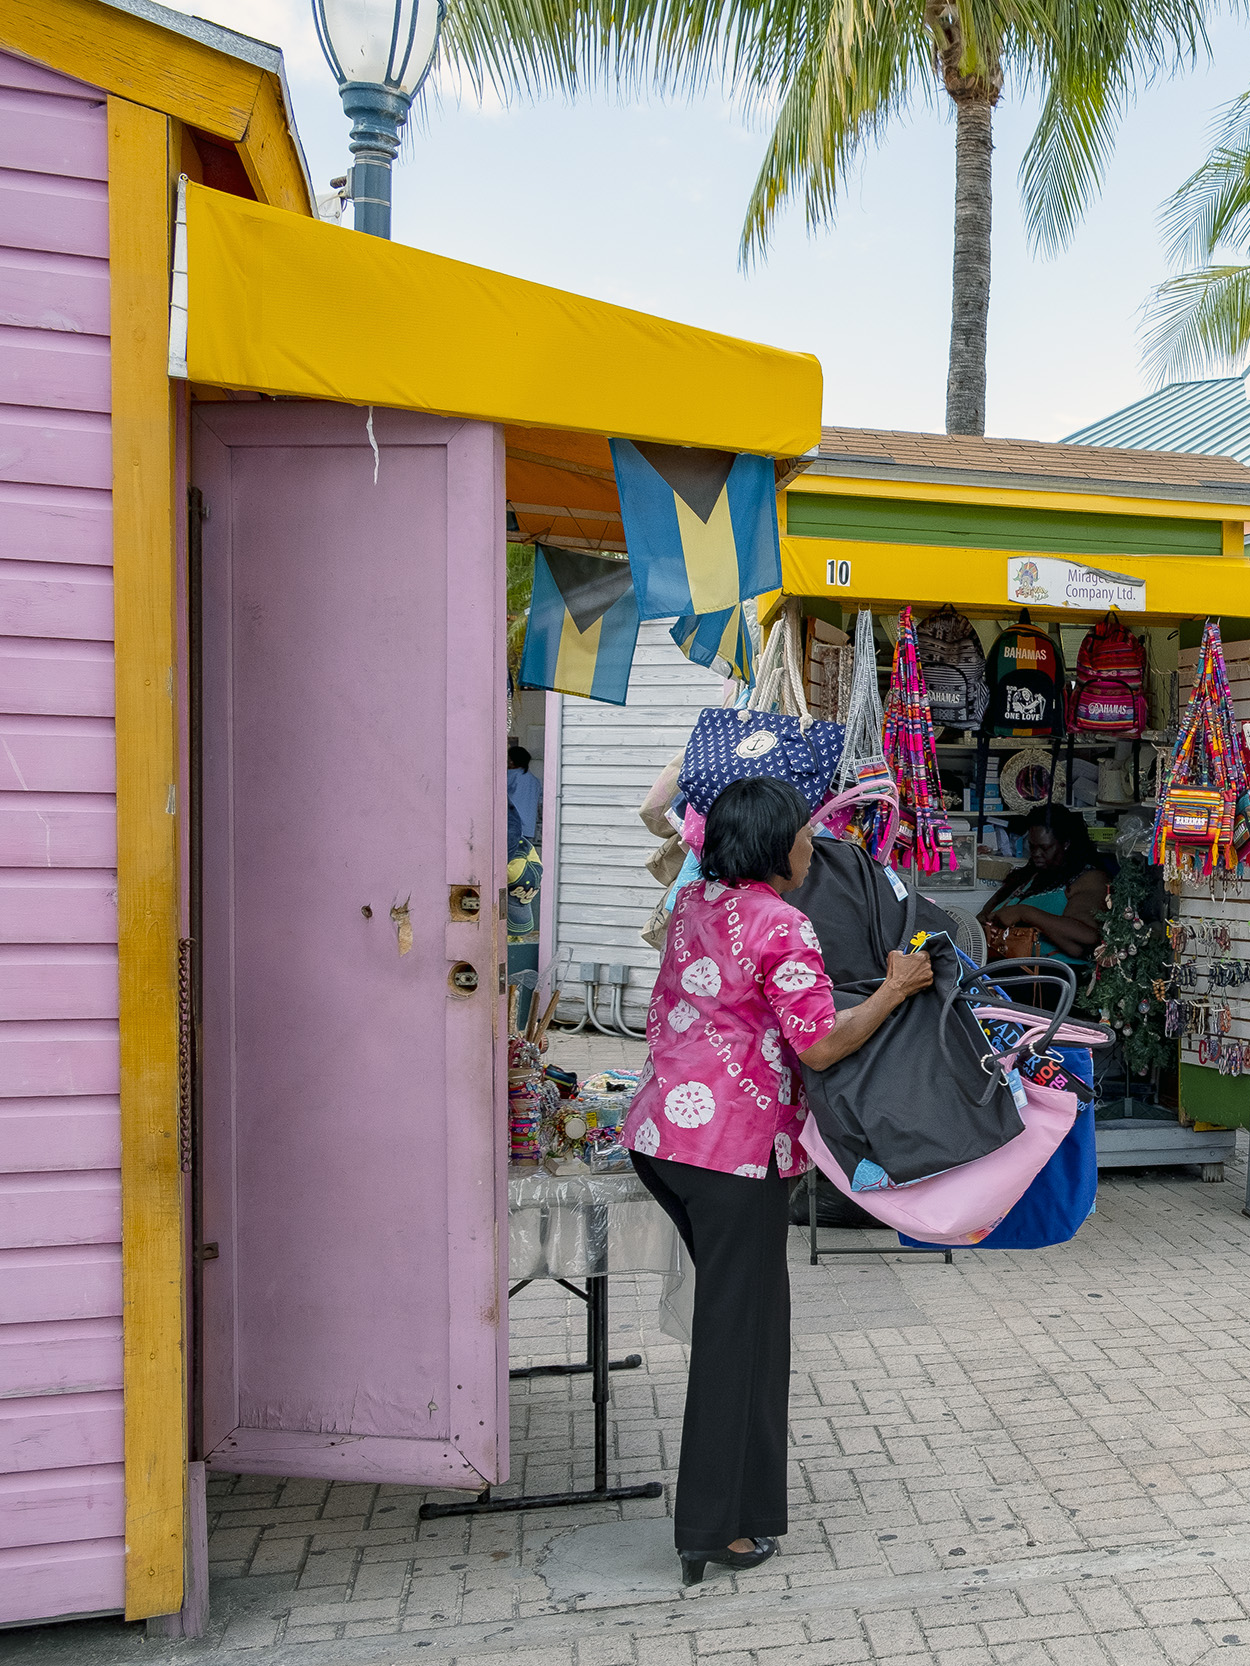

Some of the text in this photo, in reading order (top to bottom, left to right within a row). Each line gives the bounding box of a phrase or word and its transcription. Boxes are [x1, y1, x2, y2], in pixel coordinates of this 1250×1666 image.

[828, 560, 849, 585] 10
[1066, 584, 1136, 602] Company Ltd.
[1004, 646, 1047, 660] BAHAMAS
[1088, 702, 1127, 715] BAHAMAS
[1005, 712, 1040, 721] ONE LOVE
